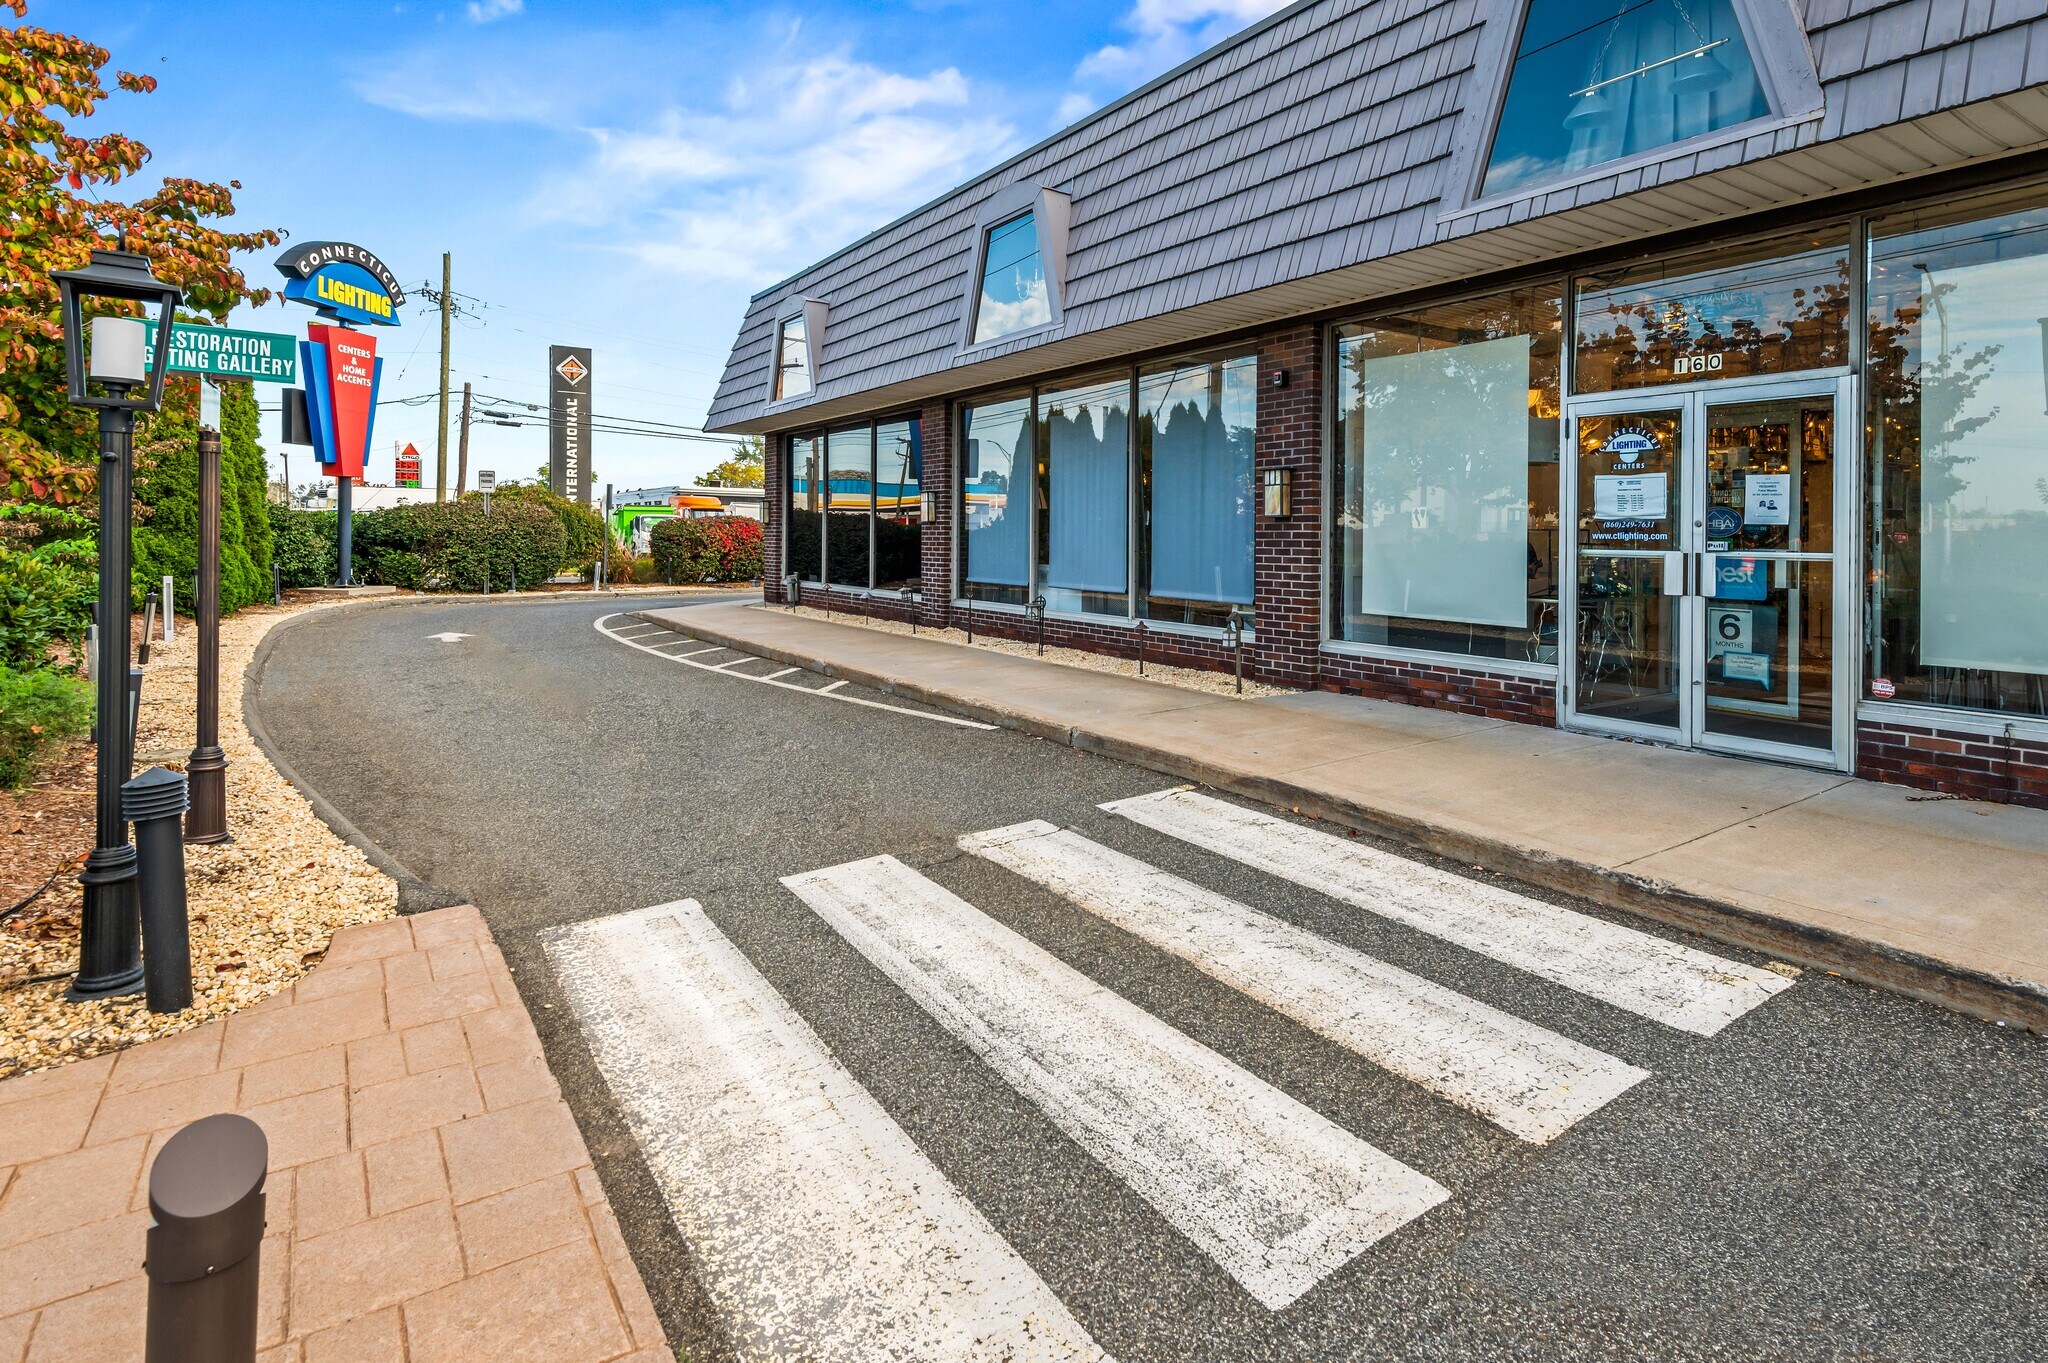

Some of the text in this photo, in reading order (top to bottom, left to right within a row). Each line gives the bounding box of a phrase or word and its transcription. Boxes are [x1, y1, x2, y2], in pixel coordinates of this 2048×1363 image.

[300, 245, 404, 304] CONNECTICUT
[317, 274, 392, 318] LIGHTING
[337, 344, 371, 359] CENTERS
[217, 353, 294, 376] GALLERY
[351, 357, 358, 365] &
[1676, 354, 1721, 373] 160
[342, 364, 366, 377] HOME
[336, 373, 372, 387] ACCENTS
[1598, 426, 1661, 452] CONNECTICUT
[1612, 439, 1647, 450] LIGHTING
[566, 398, 578, 503] NTERNATIONAL
[1613, 462, 1645, 470] CENTERS
[1603, 521, 1655, 529] (860)249-7631
[1591, 532, 1668, 541] www.ctlighting.com
[1718, 613, 1741, 640] 6
